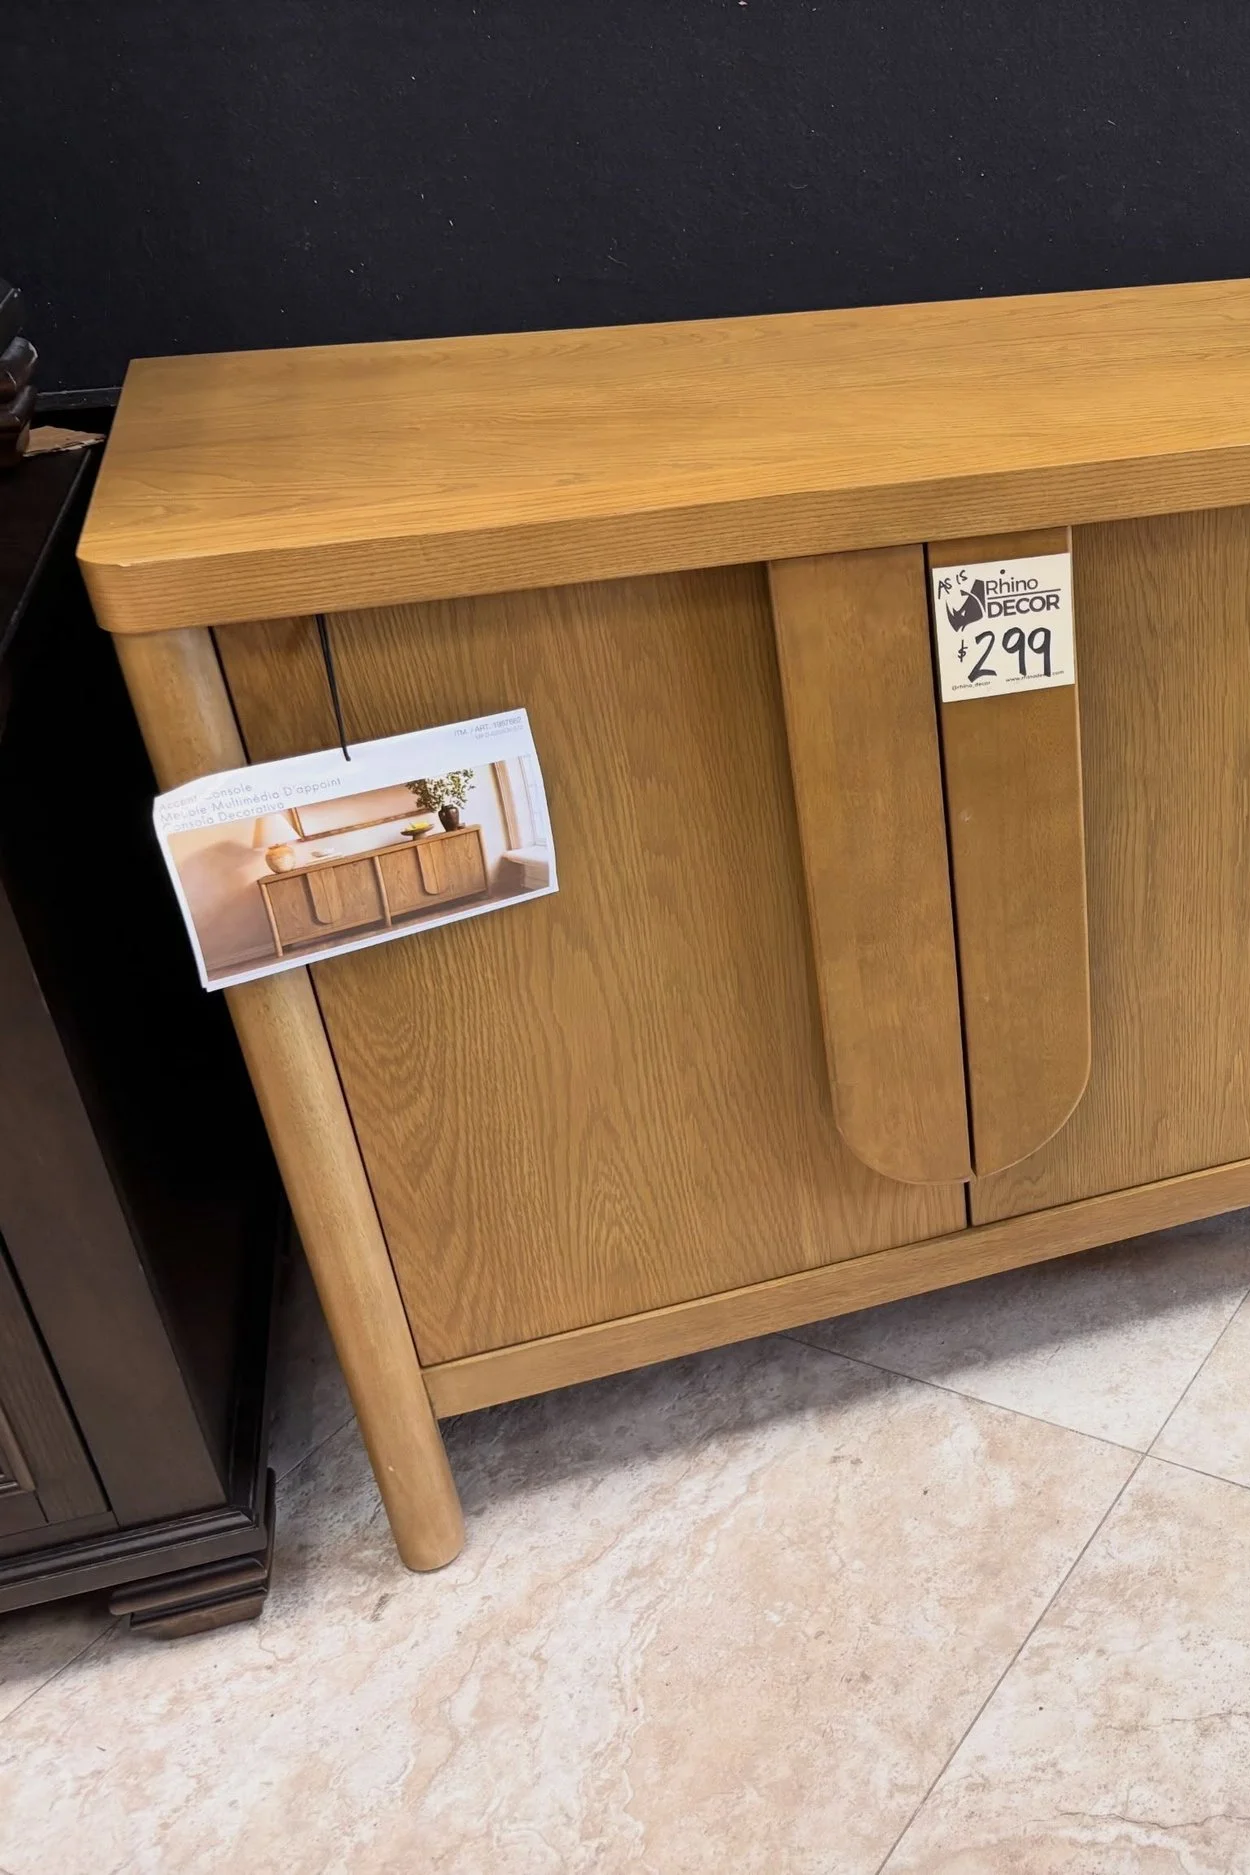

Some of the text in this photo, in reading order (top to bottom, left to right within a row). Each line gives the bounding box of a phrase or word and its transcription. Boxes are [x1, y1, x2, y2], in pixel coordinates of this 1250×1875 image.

[938, 577, 952, 599] AS
[985, 577, 1038, 596] Rhino
[987, 594, 1060, 618] DECOR
[212, 790, 280, 811] Multimédia
[283, 777, 342, 798] D'appoint
[217, 801, 285, 822] Decorativa
